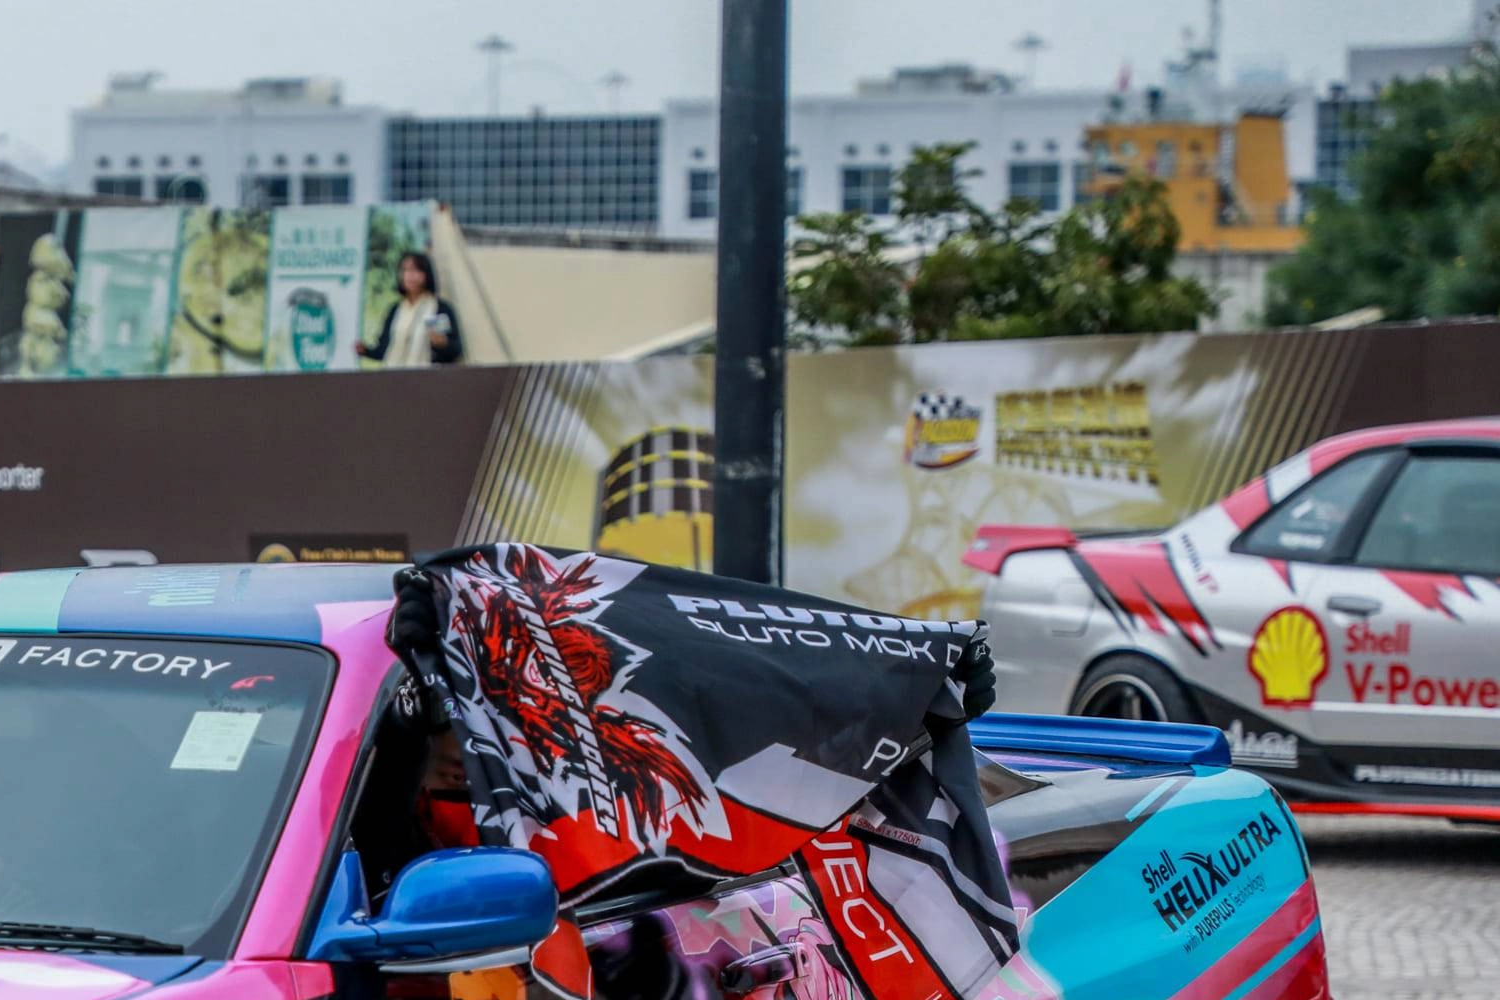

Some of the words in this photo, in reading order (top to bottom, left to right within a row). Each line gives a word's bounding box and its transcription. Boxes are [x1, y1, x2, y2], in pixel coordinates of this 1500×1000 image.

[687, 616, 831, 647] PLUTO
[842, 632, 937, 663] MOK
[1346, 621, 1411, 656] Shell
[17, 645, 231, 679] FACTORY
[811, 822, 915, 965] JECT
[1141, 850, 1176, 894] Shell
[1153, 852, 1228, 932] HELIX
[1218, 811, 1282, 878] ULTRA
[1194, 897, 1236, 942] PUREPLUS
